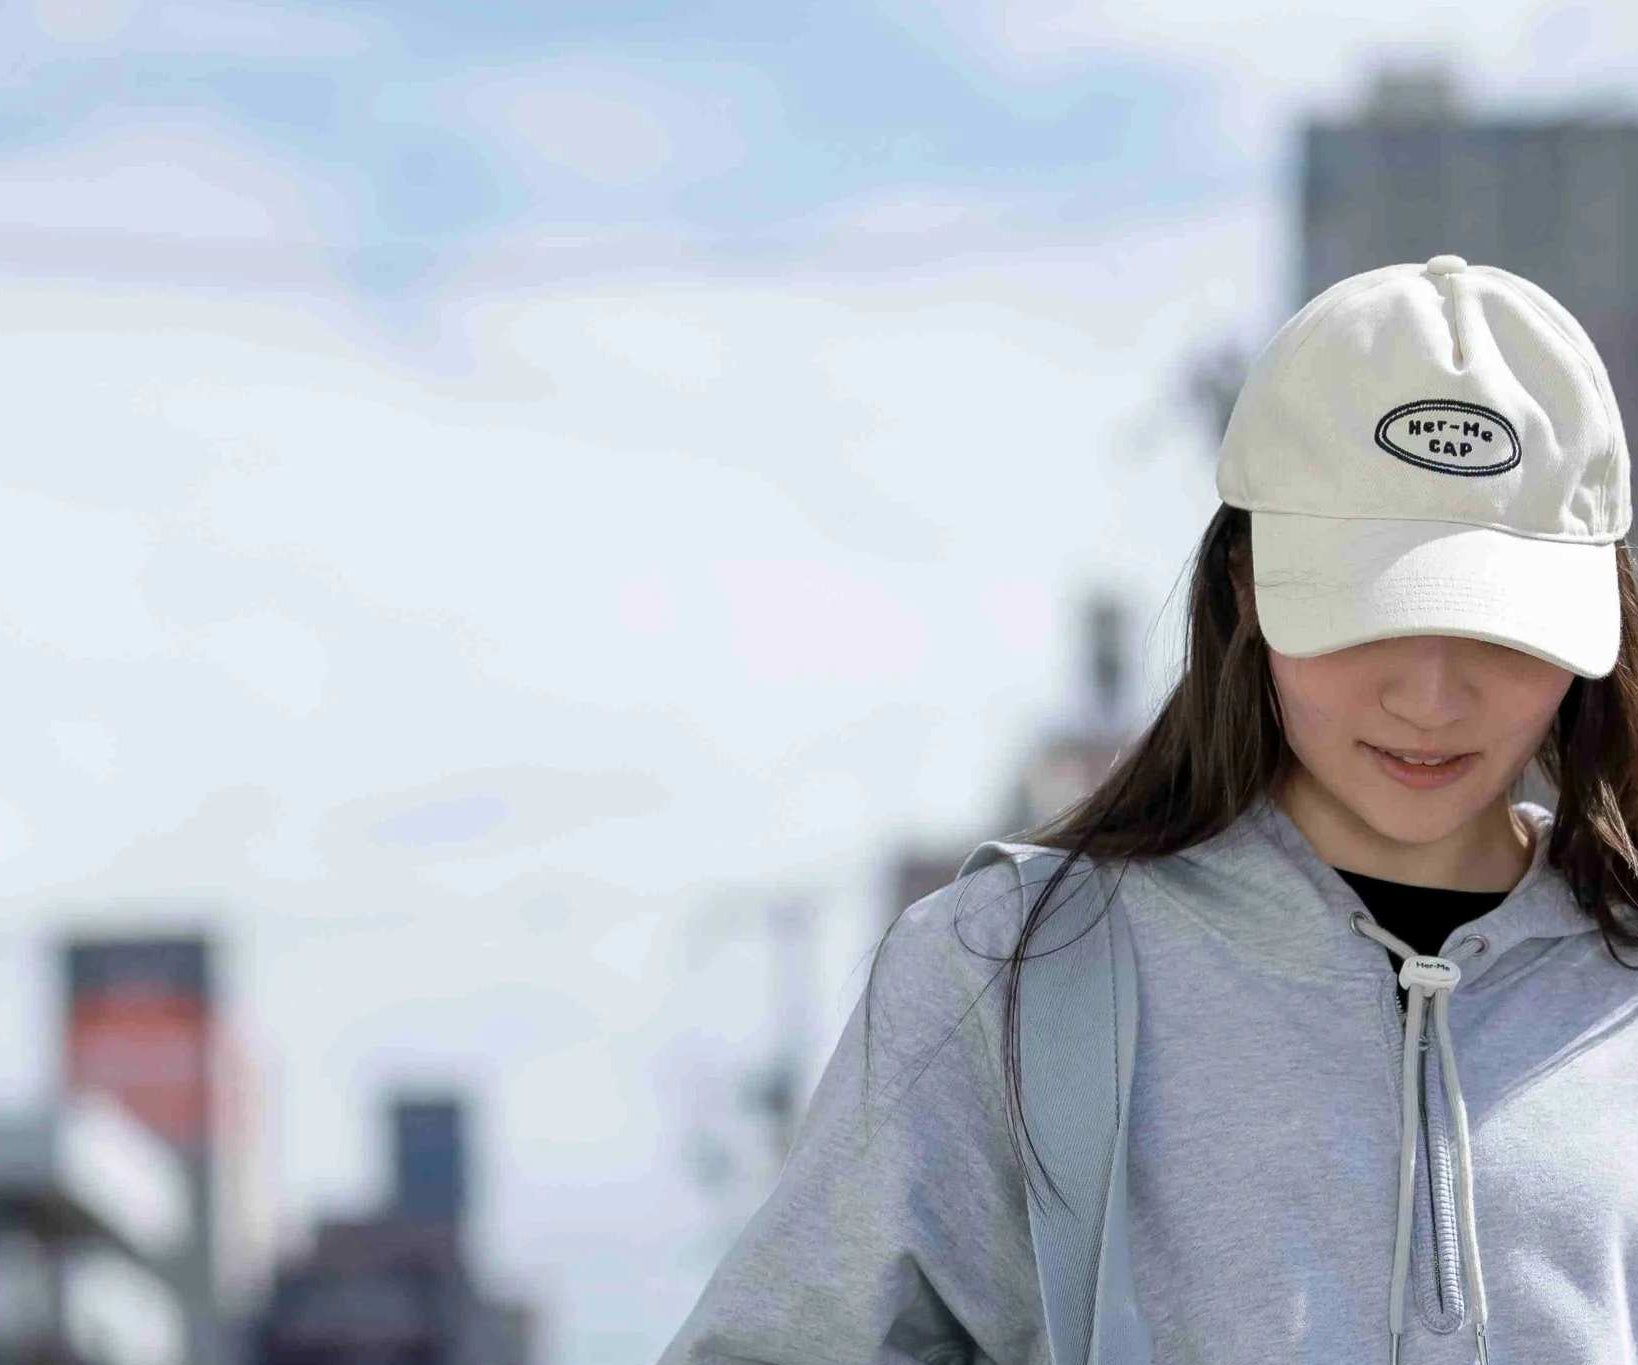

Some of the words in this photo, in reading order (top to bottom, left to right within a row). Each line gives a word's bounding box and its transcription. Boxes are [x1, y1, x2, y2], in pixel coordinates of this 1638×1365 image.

[1409, 420, 1493, 443] Her-Me
[1429, 439, 1473, 457] CAP
[1416, 961, 1451, 971] Her-Me
